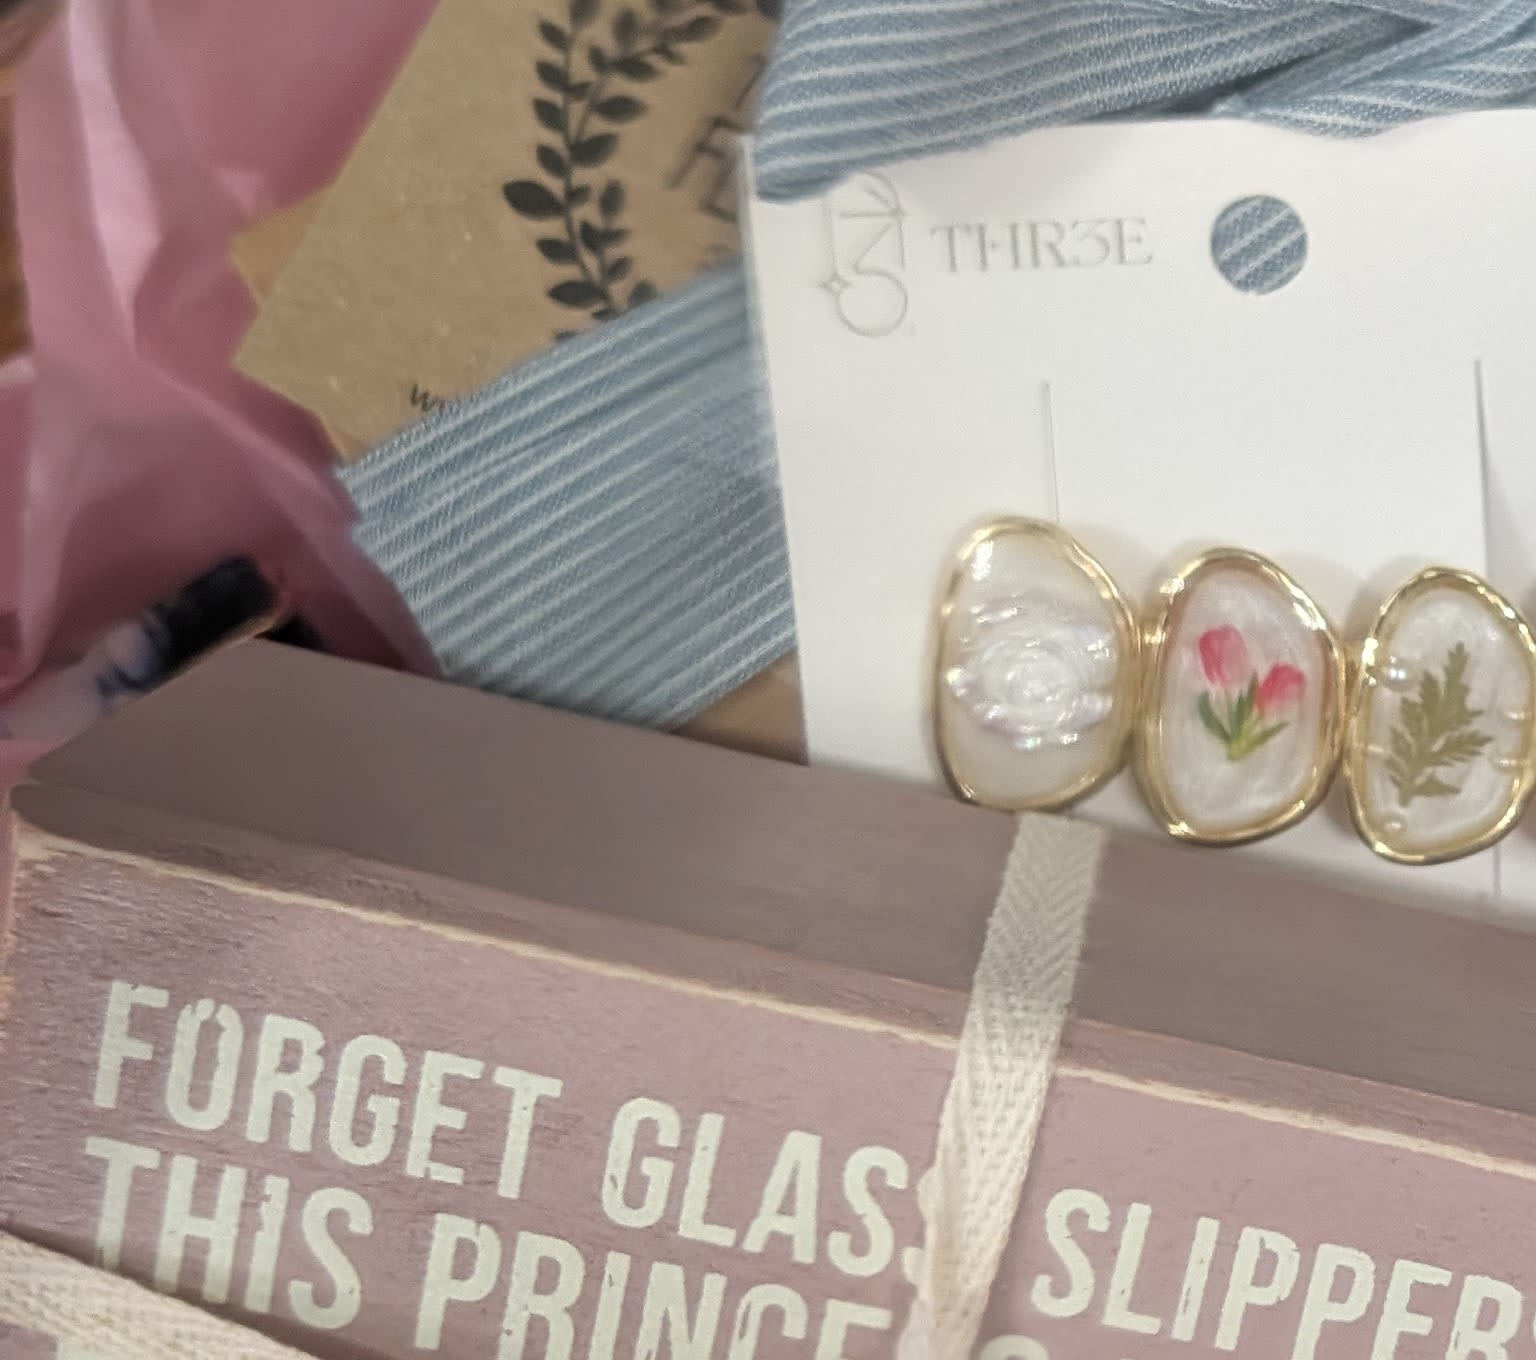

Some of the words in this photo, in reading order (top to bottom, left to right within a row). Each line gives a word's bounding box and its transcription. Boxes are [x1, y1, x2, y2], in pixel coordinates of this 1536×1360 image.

[84, 1136, 374, 1331] THIS
[92, 979, 564, 1200] FORGET
[600, 1096, 930, 1288] GLAS
